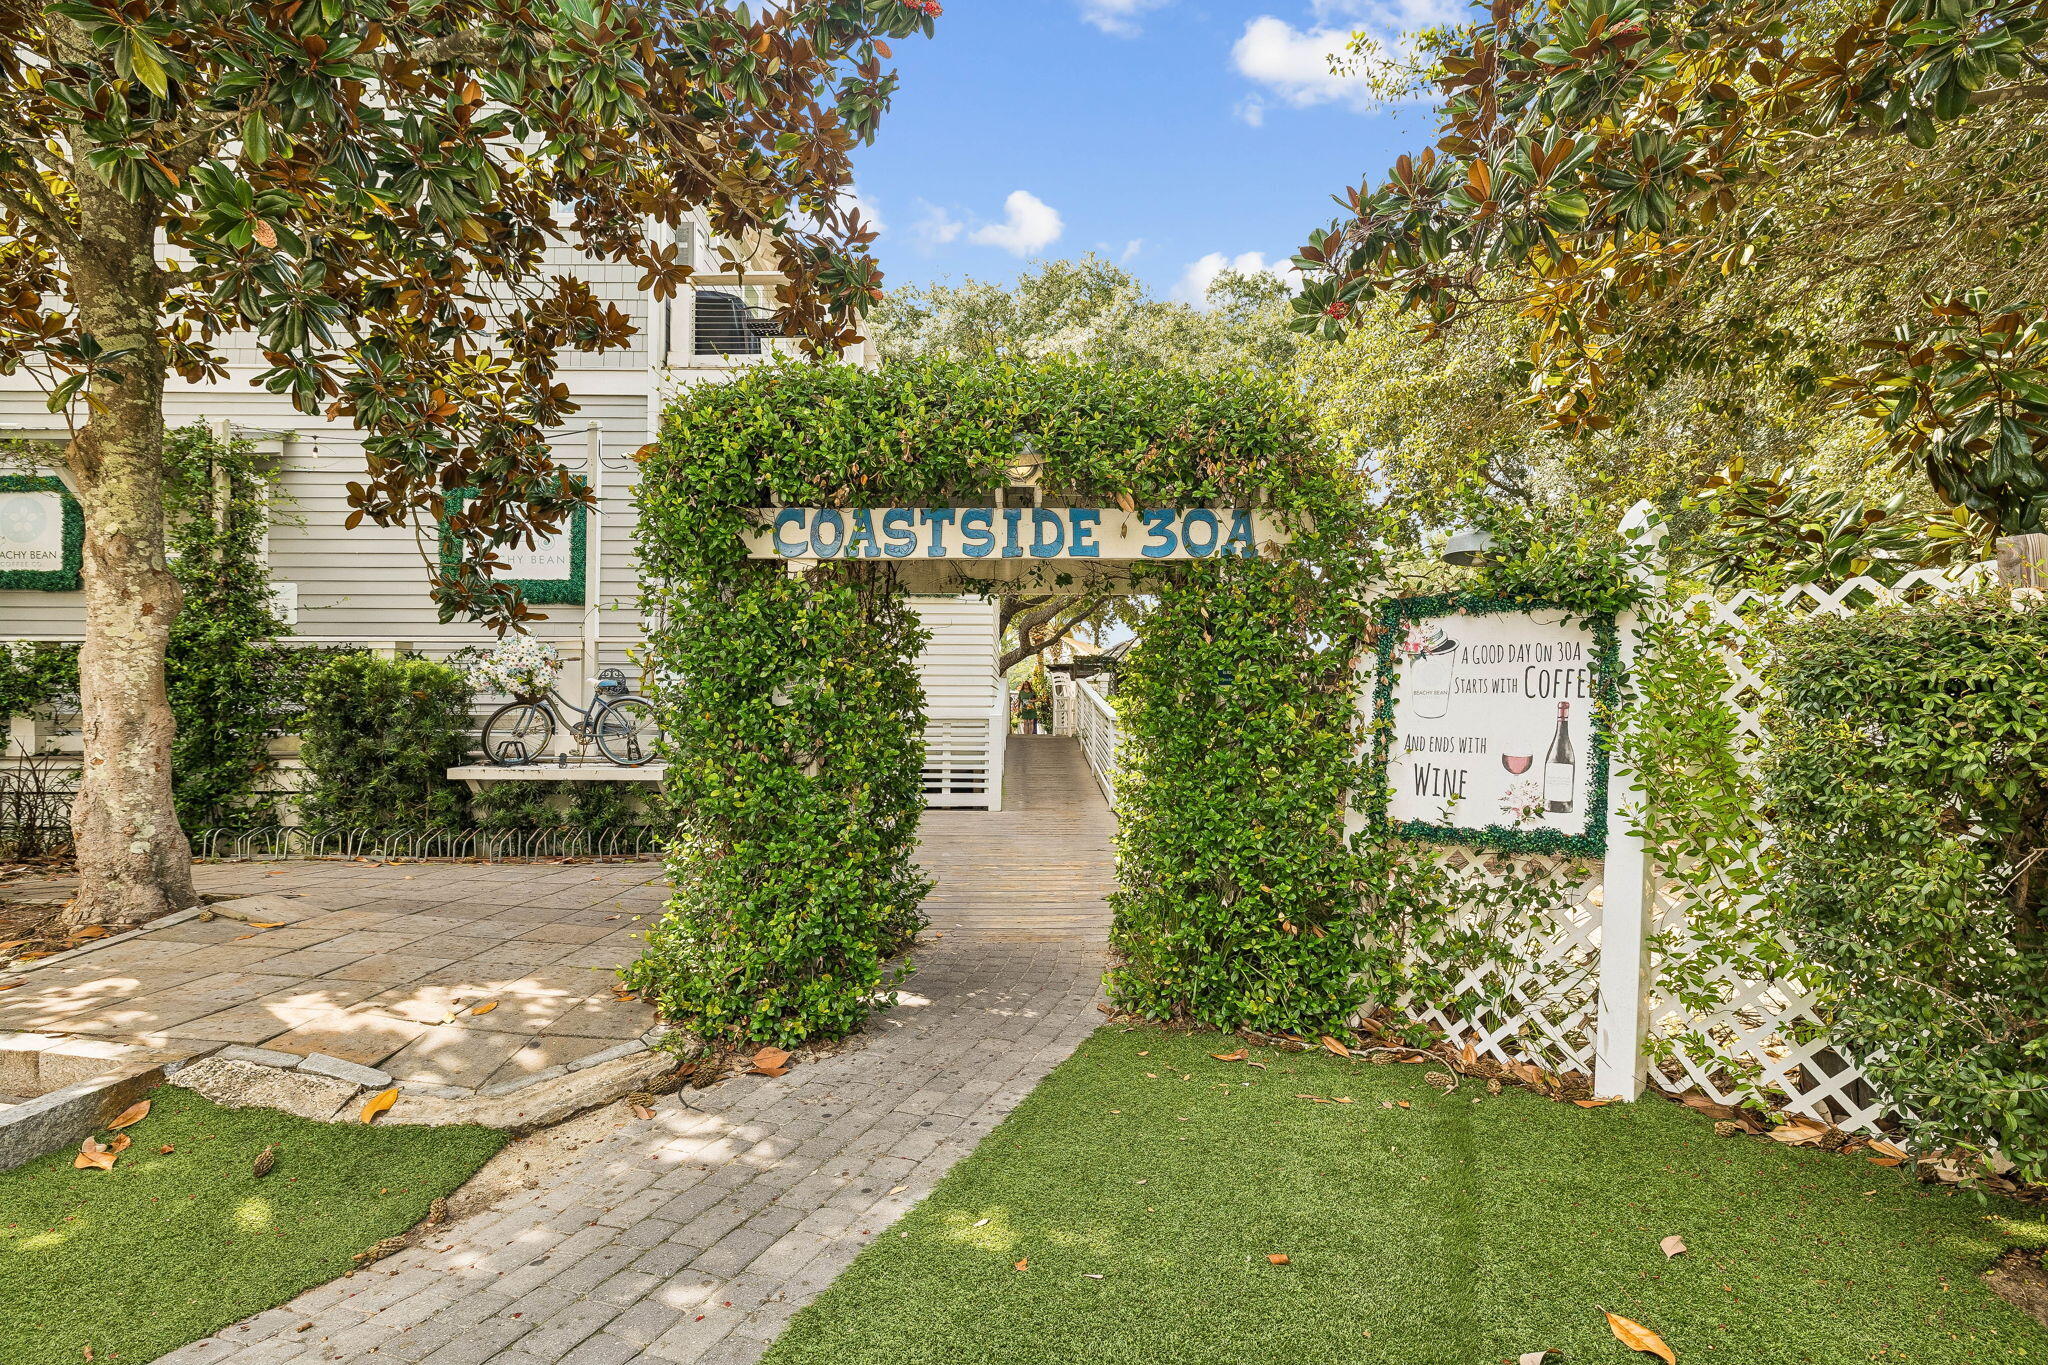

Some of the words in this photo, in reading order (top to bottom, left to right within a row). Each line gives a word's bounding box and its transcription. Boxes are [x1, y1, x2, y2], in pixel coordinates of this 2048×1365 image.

[773, 508, 1101, 558] COASTSIDE
[1141, 508, 1258, 558] 30A
[30, 550, 57, 559] BEAN
[531, 555, 565, 565] BEAN
[1461, 646, 1468, 665] A
[1472, 644, 1504, 665] GOOD
[1508, 643, 1531, 663] DAY
[1535, 642, 1552, 663] ON
[1557, 641, 1581, 661] 30A
[1454, 676, 1488, 694] STARTS
[1491, 678, 1518, 694] WITH
[1403, 733, 1426, 752] AND
[1429, 736, 1455, 753] ENDS
[1458, 737, 1487, 754] WITH
[1414, 762, 1468, 800] WINE
